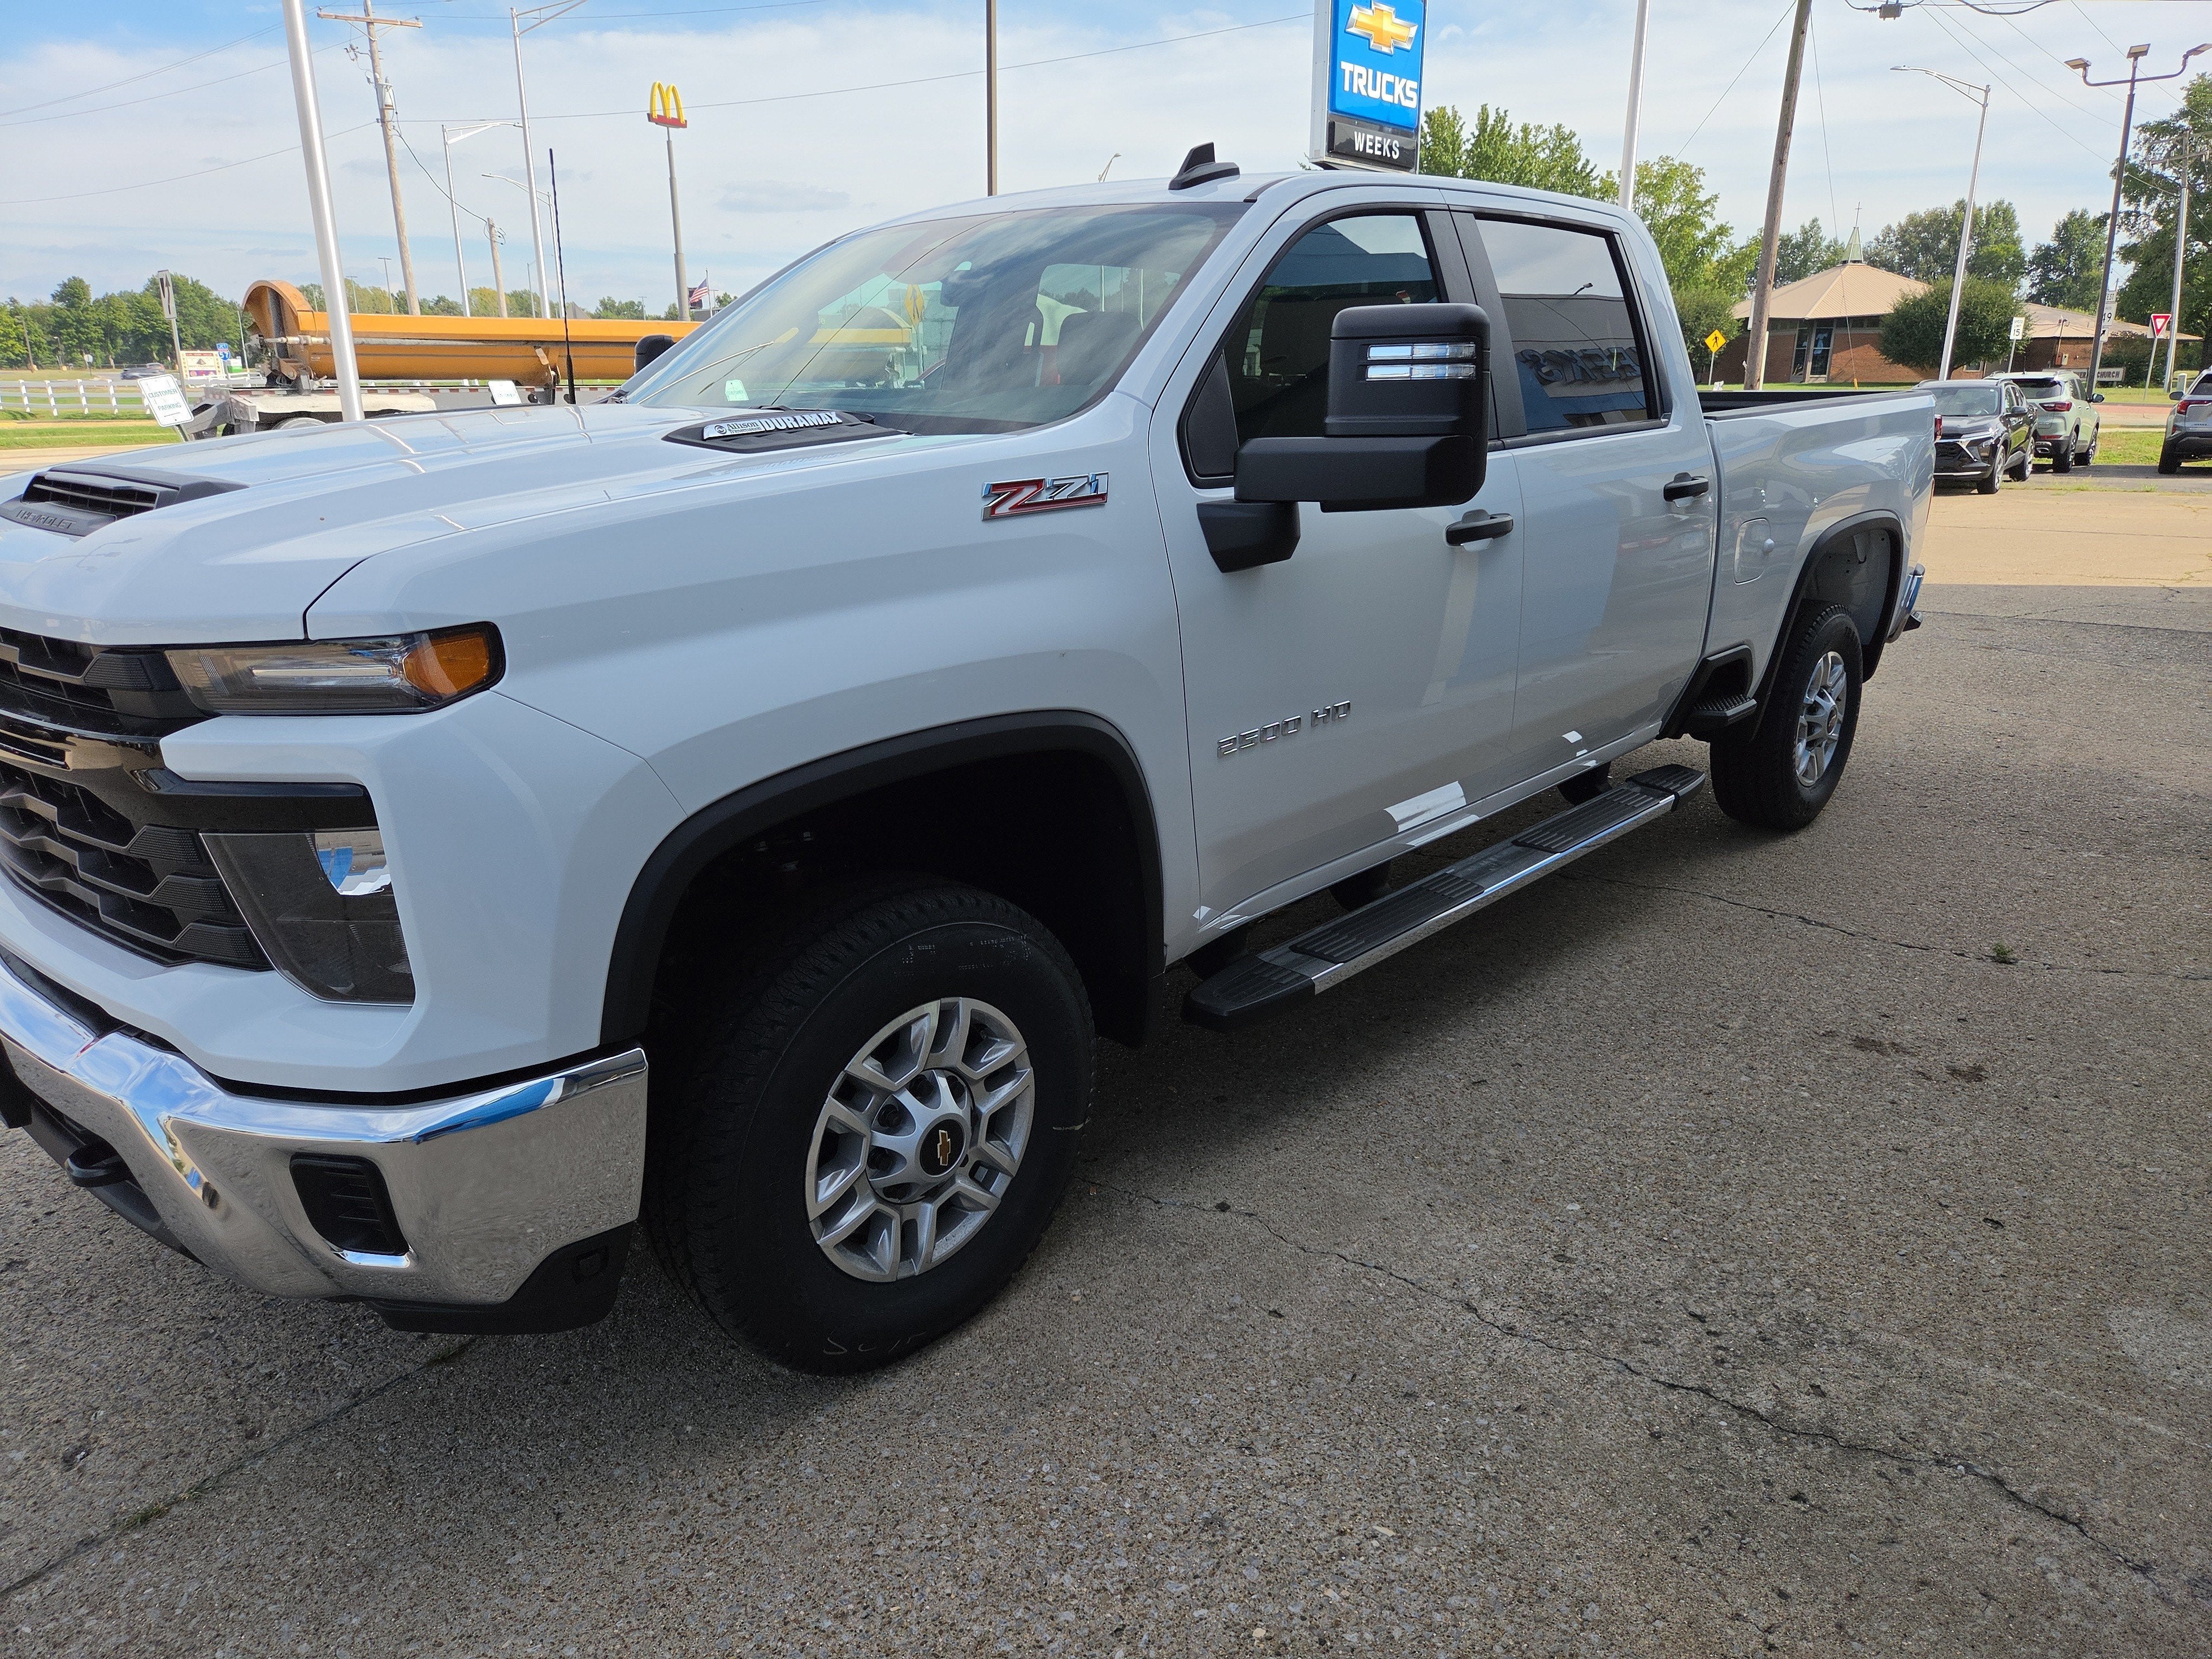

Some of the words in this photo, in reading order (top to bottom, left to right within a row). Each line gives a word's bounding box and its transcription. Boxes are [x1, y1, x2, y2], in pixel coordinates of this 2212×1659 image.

[1340, 61, 1418, 108] TRUCKS
[1354, 131, 1400, 159] WEEKS
[148, 388, 178, 398] CUSTOMER
[158, 402, 182, 411] PARKING
[726, 421, 760, 430] Allison
[759, 411, 843, 431] DURAMAX
[981, 471, 1109, 522] Z71
[16, 509, 77, 530] CHEVROLET
[1217, 715, 1302, 759] 2500
[1310, 700, 1351, 728] HD
